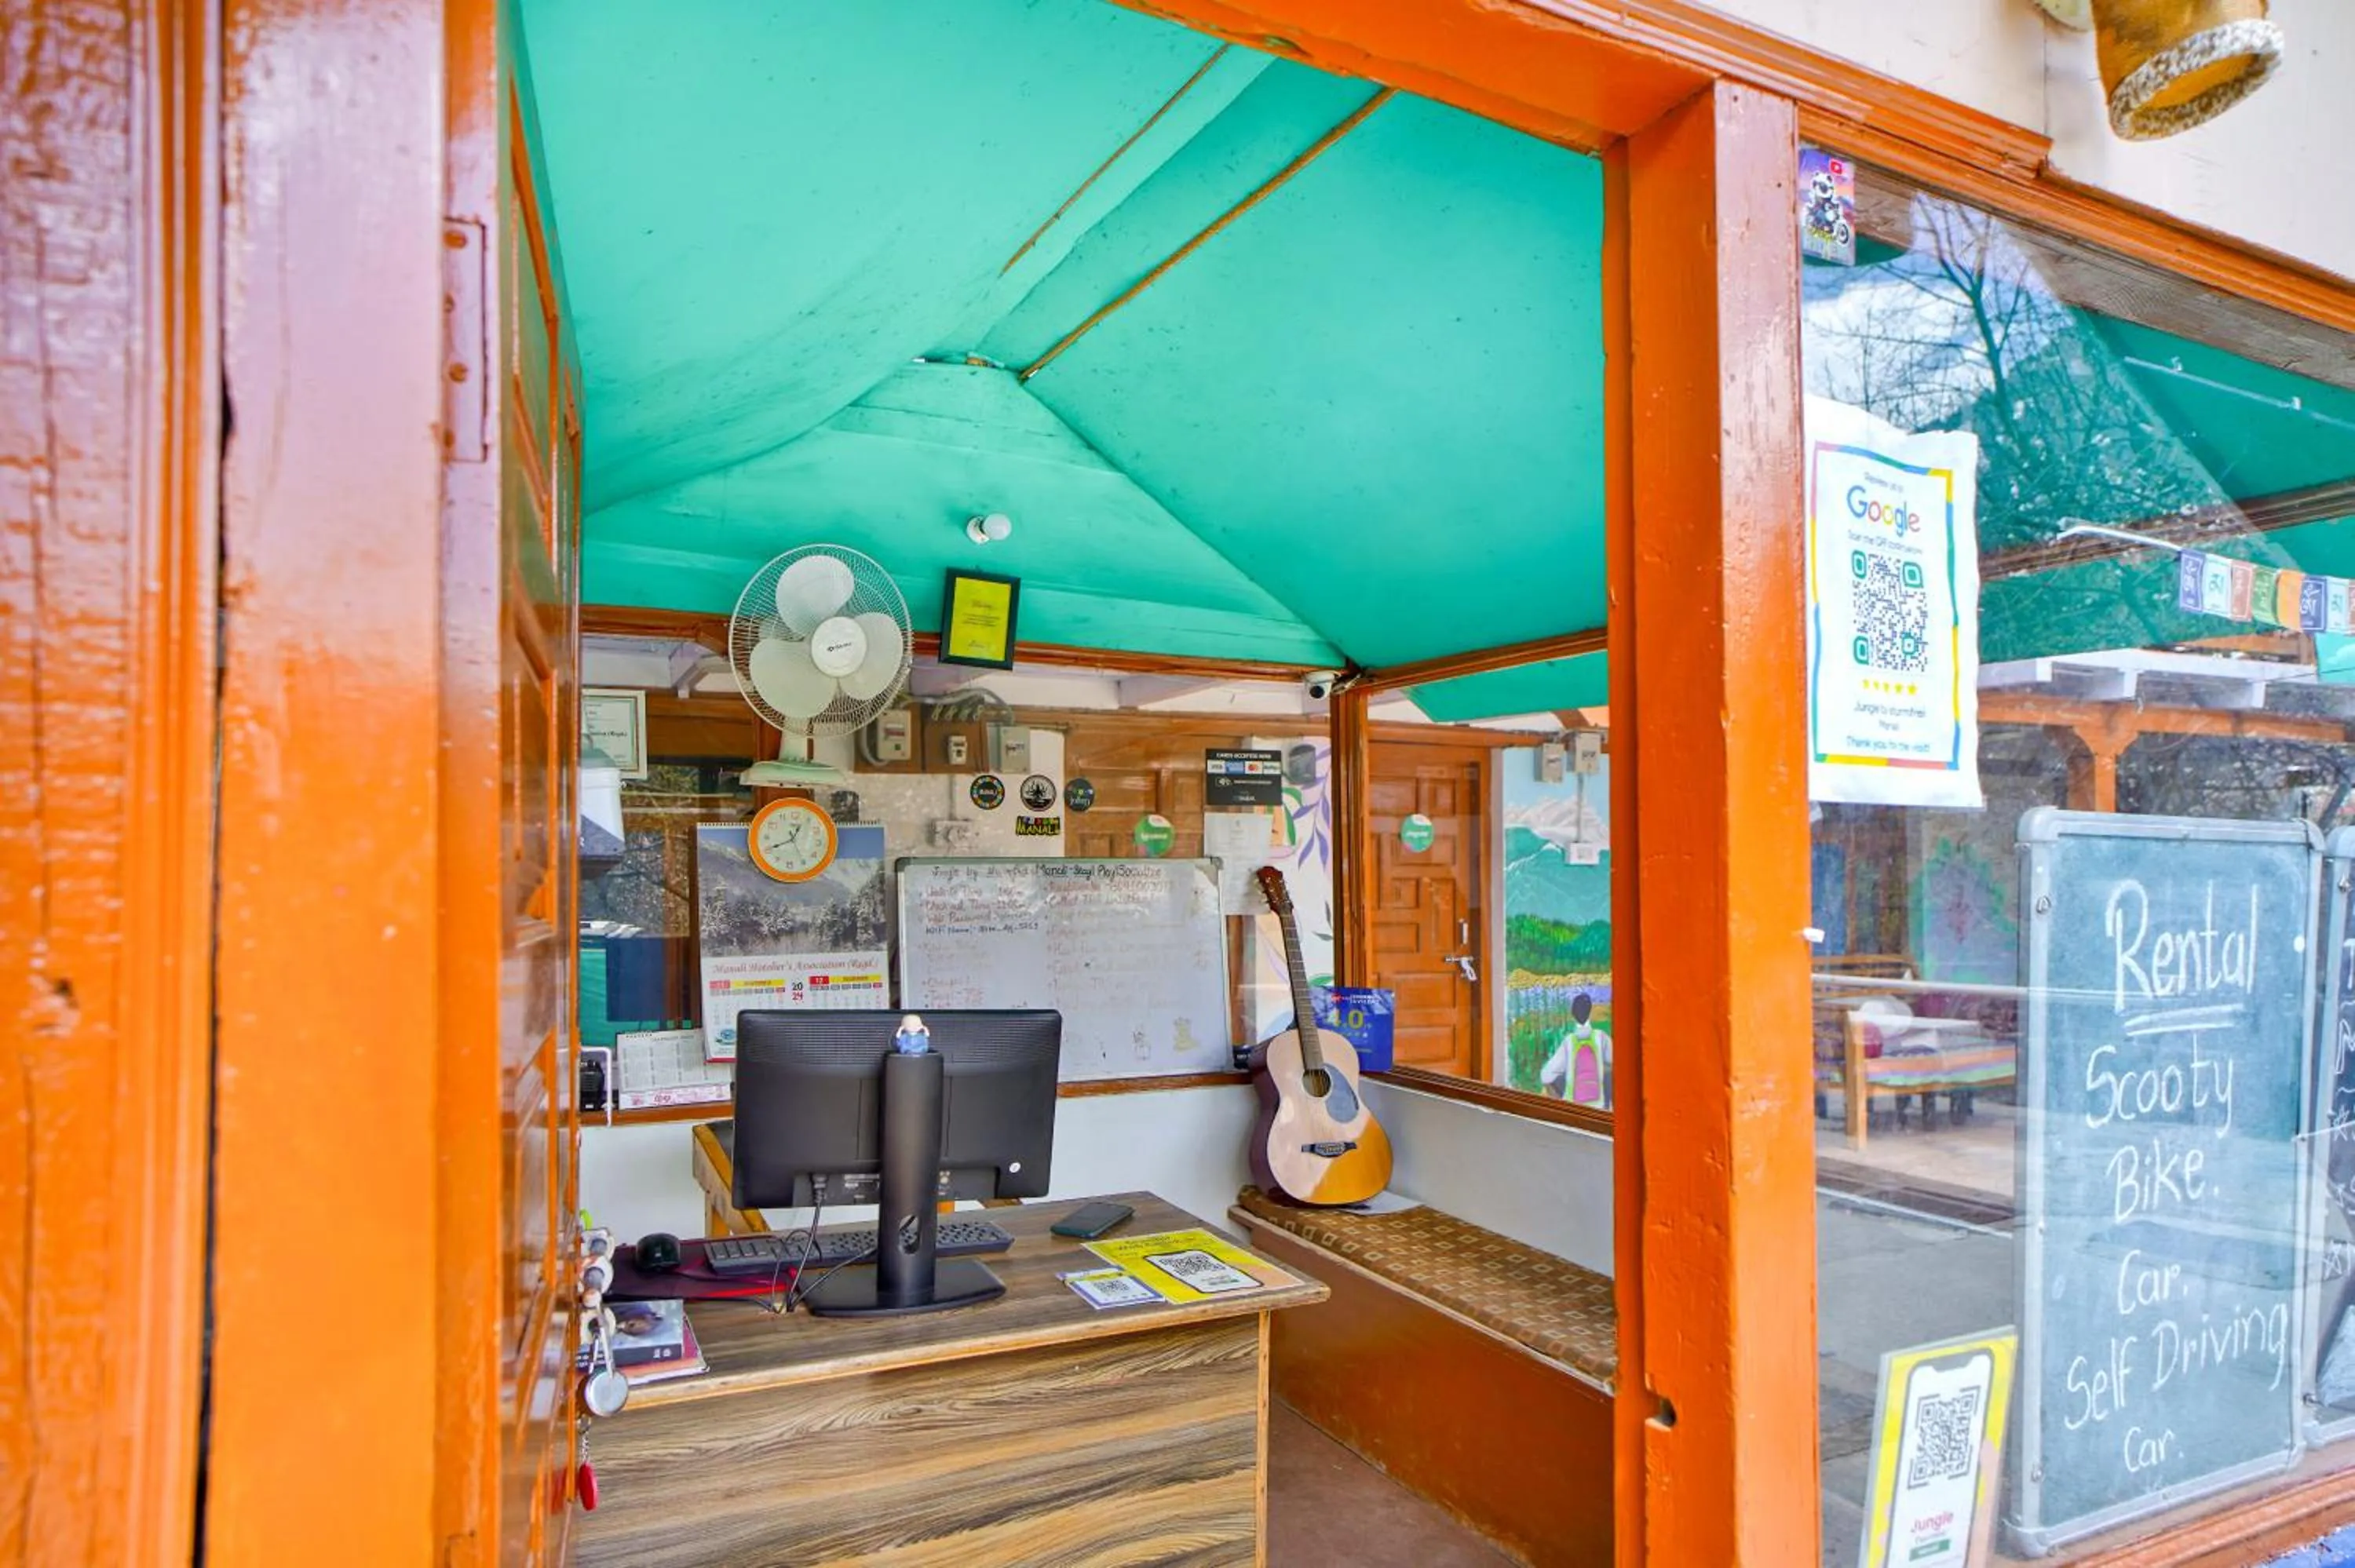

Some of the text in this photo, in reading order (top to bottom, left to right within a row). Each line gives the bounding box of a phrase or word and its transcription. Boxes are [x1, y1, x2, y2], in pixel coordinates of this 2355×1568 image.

[1846, 484, 1922, 538] Google
[2105, 878, 2259, 1016] Rental
[791, 982, 804, 991] 20
[791, 992, 804, 1001] 24
[2085, 1033, 2234, 1139] Scooty
[2105, 1137, 2220, 1224] Bike.
[2117, 1249, 2189, 1315] Car.
[2064, 1302, 2288, 1430] Self Driving
[2123, 1426, 2185, 1473] Car.
[1910, 1510, 1954, 1533] Jungle
